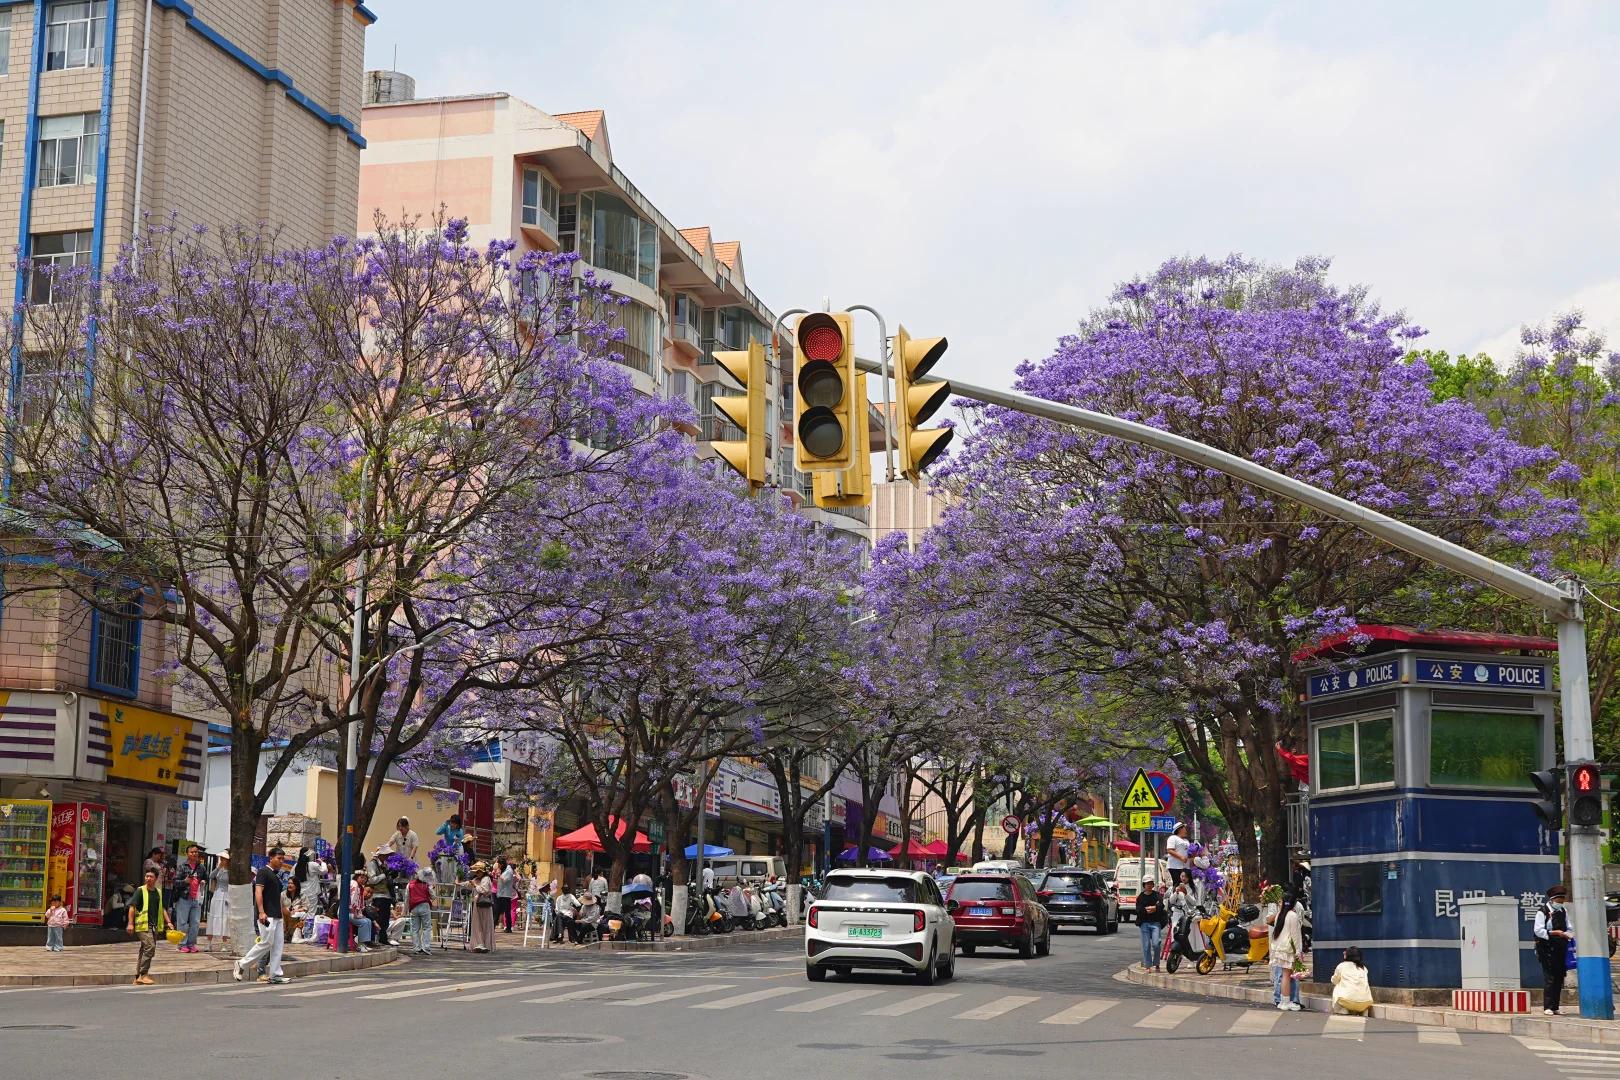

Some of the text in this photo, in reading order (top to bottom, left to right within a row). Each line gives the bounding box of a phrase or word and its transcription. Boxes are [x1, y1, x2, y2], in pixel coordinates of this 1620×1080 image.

[1320, 664, 1393, 692] 公安 POLICE
[1431, 664, 1540, 684] 公安 POLICE
[1435, 889, 1545, 921] 昆警
